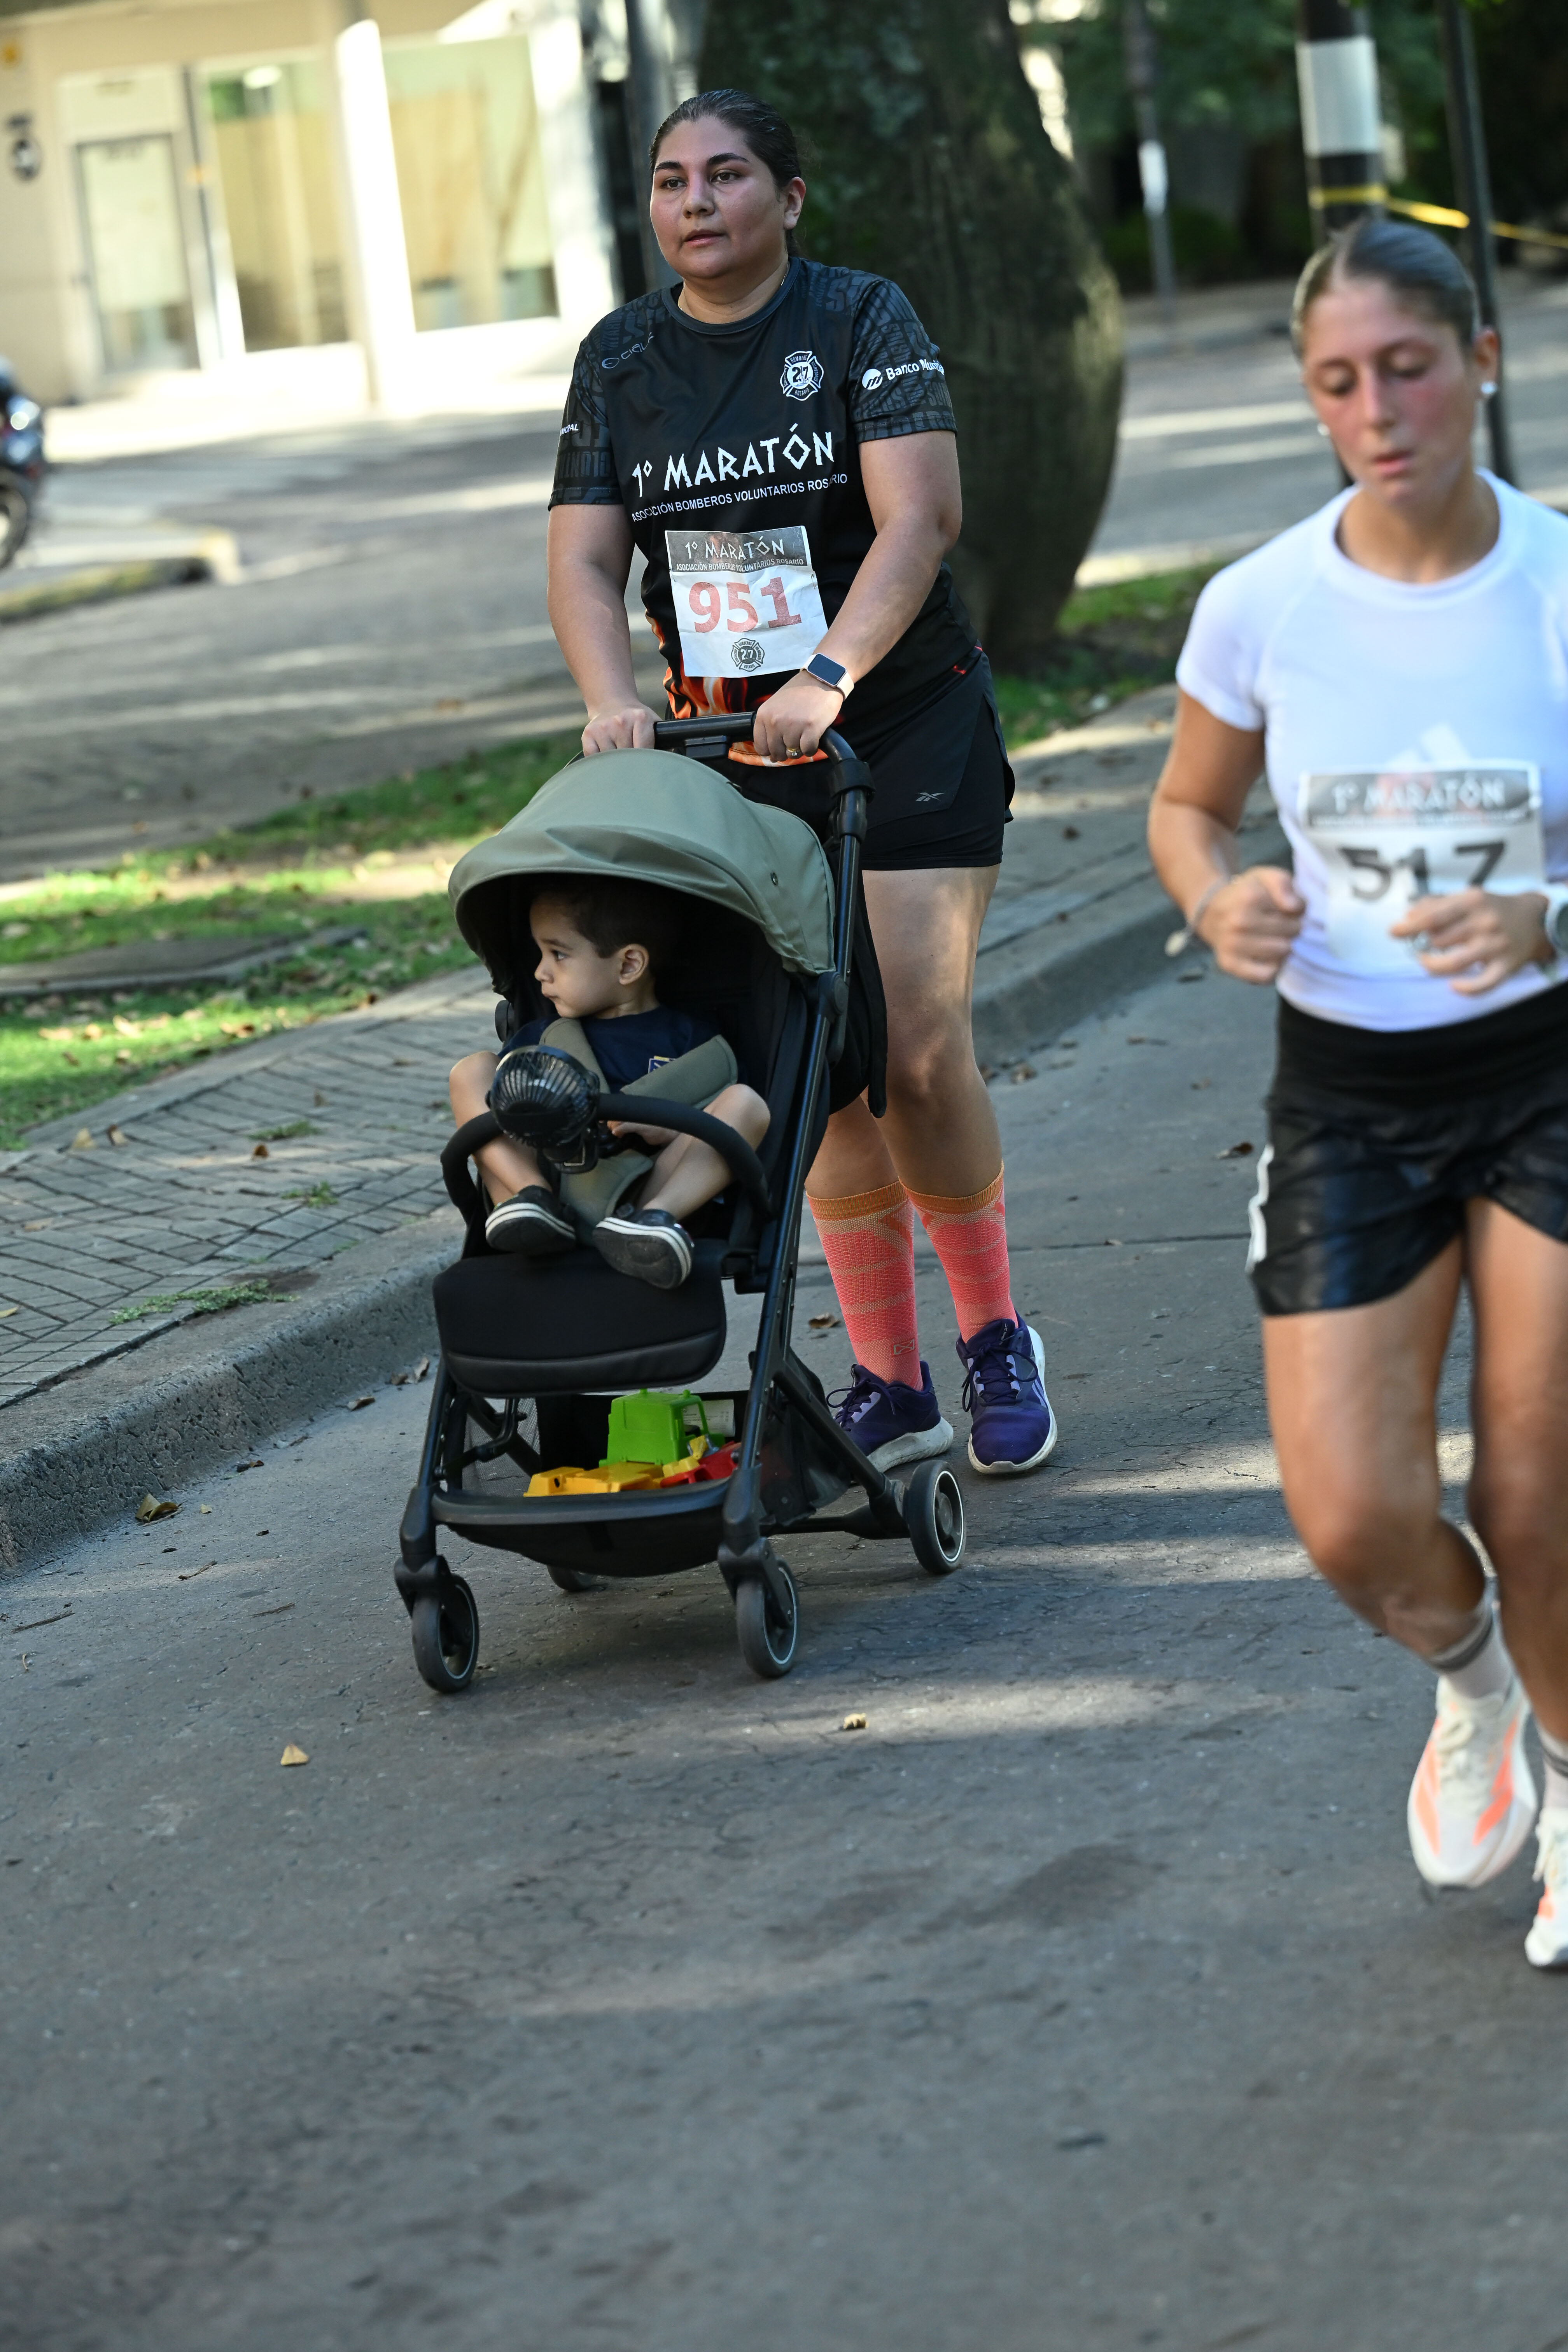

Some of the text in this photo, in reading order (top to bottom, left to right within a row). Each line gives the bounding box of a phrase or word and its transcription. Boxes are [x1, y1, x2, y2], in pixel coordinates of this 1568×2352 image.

[792, 366, 808, 383] 27
[886, 363, 920, 380] Banco
[664, 423, 835, 491] MARATÓN
[675, 494, 732, 511] BOMBEROS
[734, 482, 805, 502] VOLUNTARIOS
[705, 536, 784, 560] MARATÓN
[735, 558, 775, 572] VOLUNTARIOS
[689, 577, 802, 633] 951
[740, 649, 753, 660] 27
[1363, 772, 1505, 813] MARATÓN
[1338, 839, 1506, 902] 517
